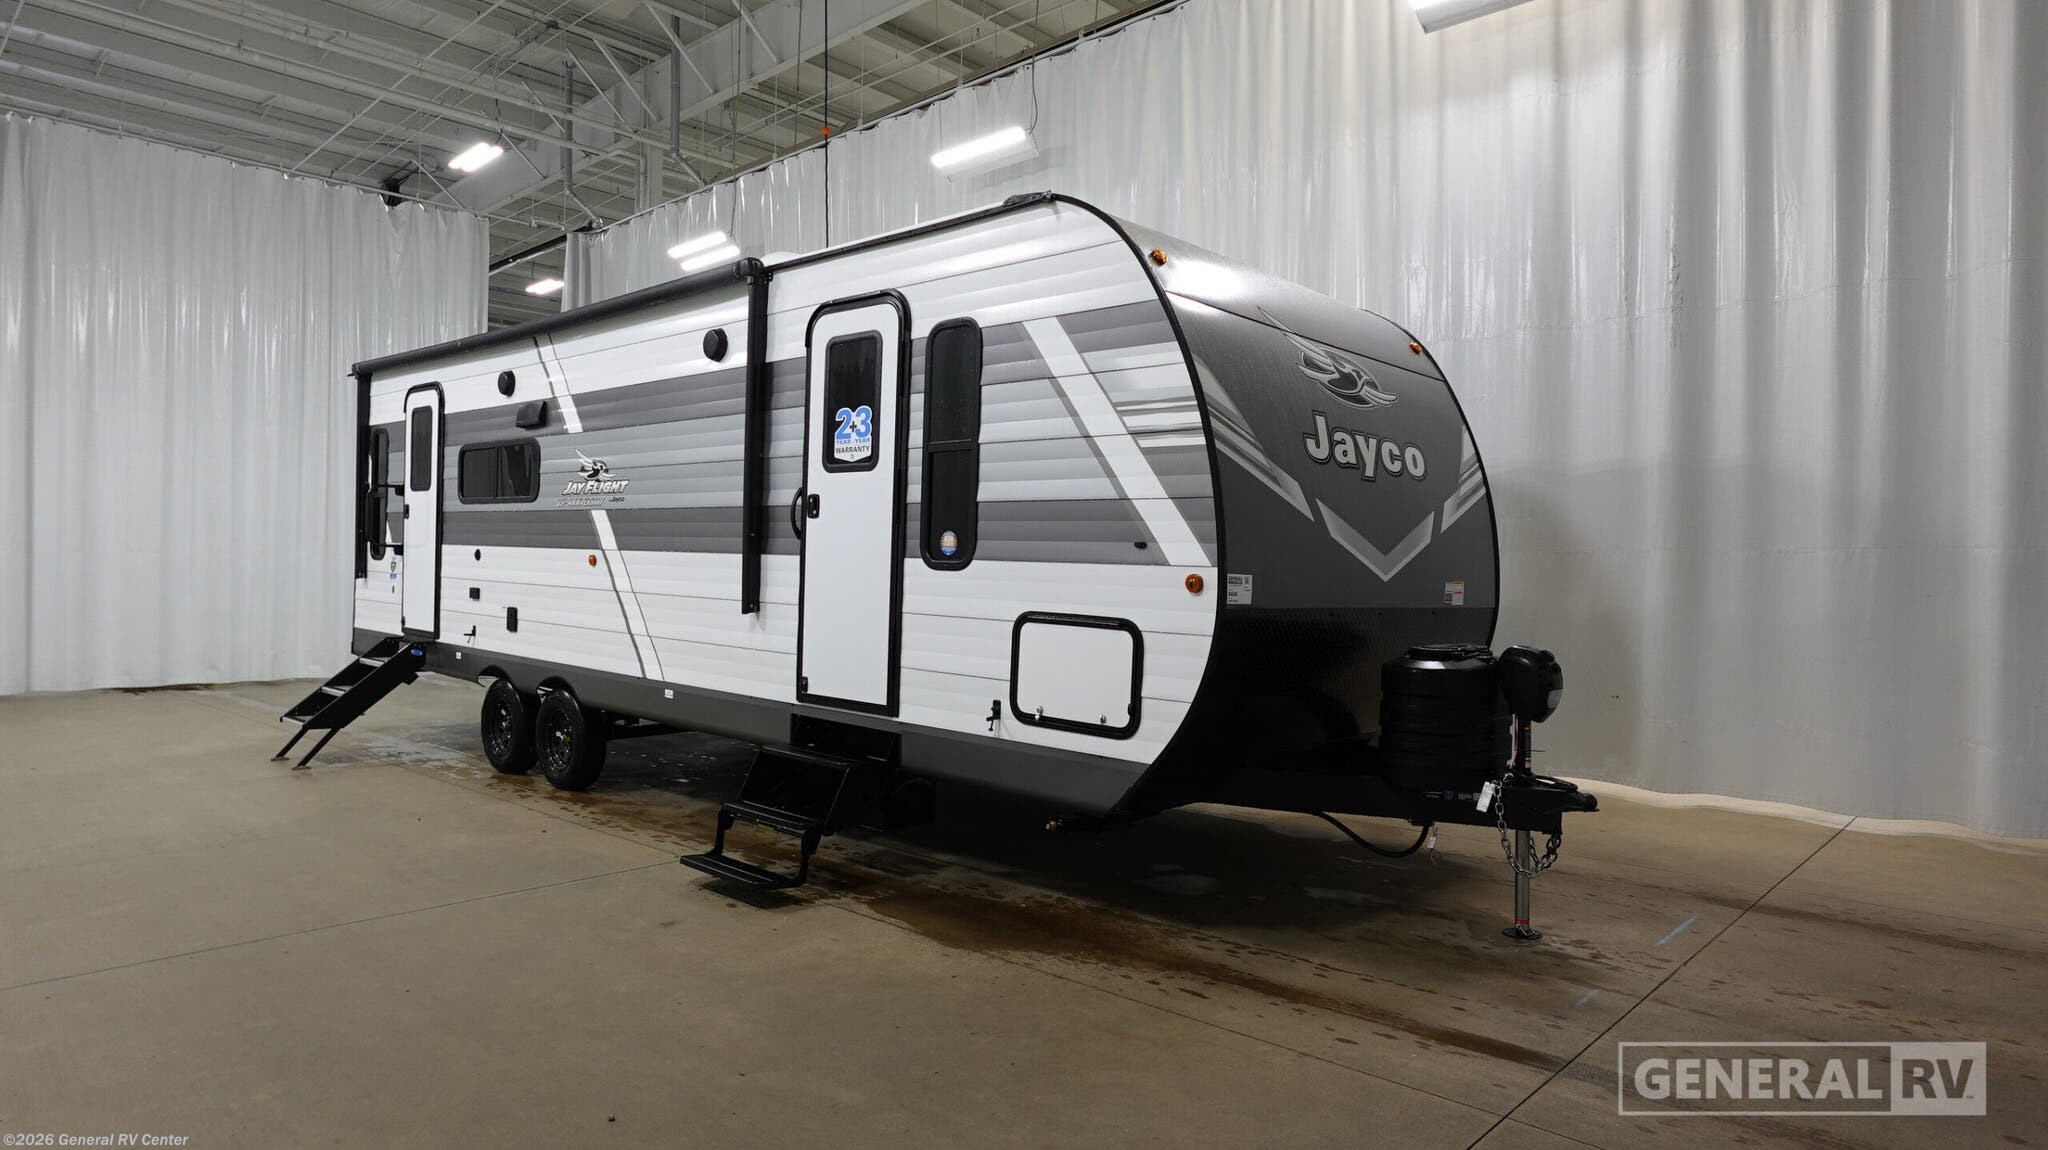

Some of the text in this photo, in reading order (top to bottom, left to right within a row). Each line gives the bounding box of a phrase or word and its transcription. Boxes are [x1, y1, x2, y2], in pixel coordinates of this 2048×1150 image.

[1303, 410, 1427, 482] Jayco
[562, 479, 630, 495] JAY FLIGHT
